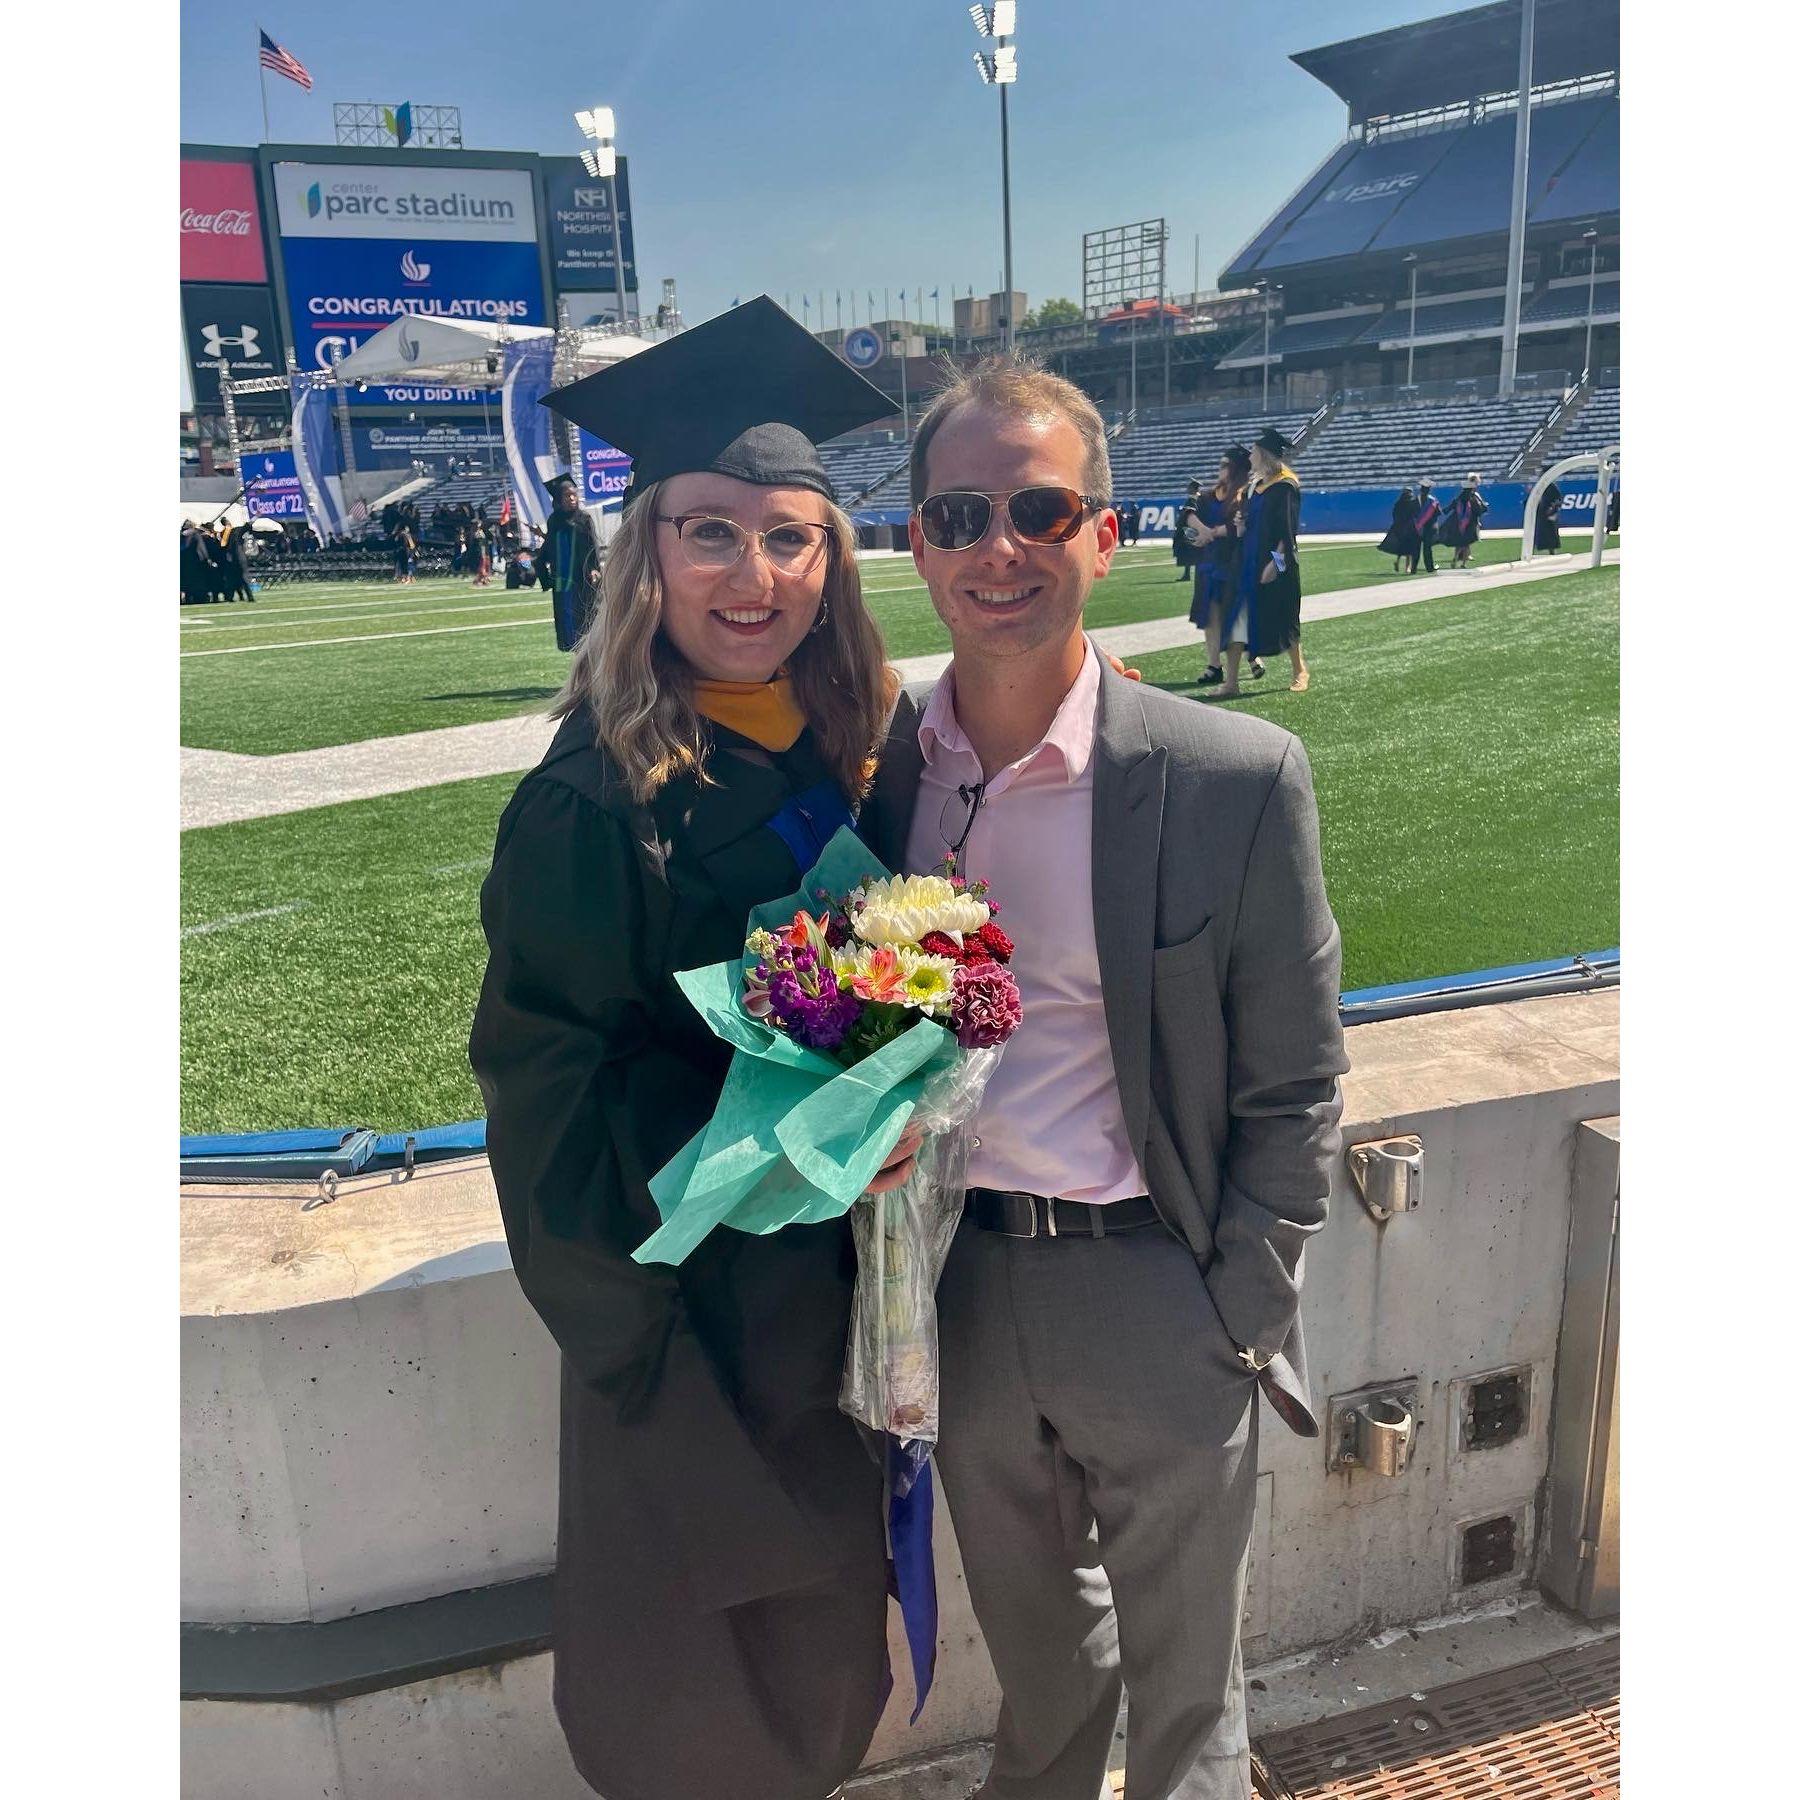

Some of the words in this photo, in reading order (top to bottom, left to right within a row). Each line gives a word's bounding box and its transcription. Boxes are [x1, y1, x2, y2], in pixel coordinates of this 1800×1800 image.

[331, 184, 379, 195] center
[325, 194, 390, 221] parc
[395, 193, 515, 219] stadium
[307, 296, 529, 318] CONGRATULATIONS
[384, 388, 420, 401] YOU
[424, 388, 453, 401] DID
[456, 388, 477, 401] IT!
[588, 470, 629, 493] Class
[248, 496, 276, 515] Class
[275, 495, 287, 514] of
[286, 494, 304, 513] '22
[1138, 506, 1176, 532] PA
